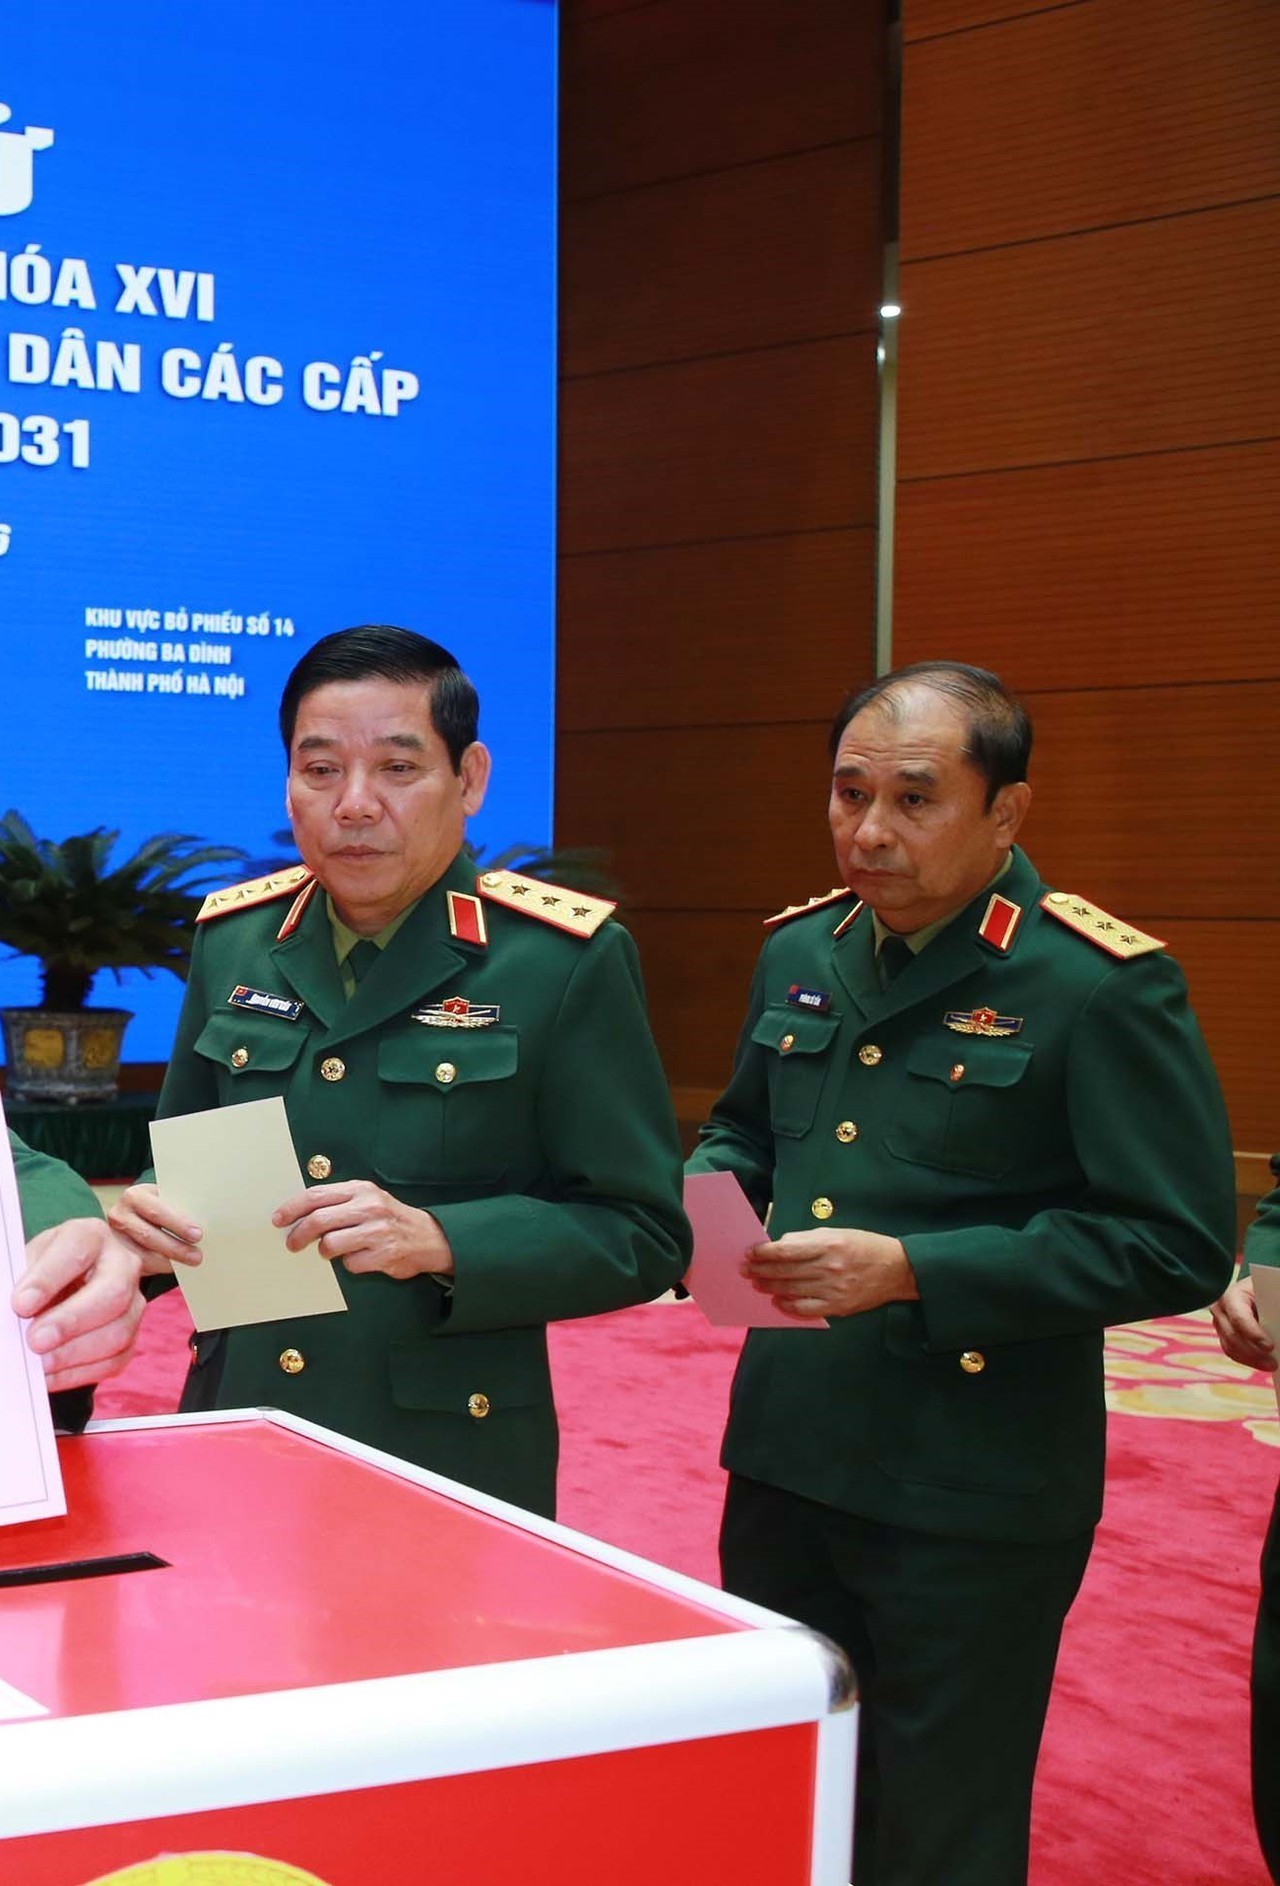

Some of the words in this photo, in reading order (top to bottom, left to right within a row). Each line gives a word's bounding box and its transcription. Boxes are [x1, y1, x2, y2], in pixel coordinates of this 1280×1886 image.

[116, 263, 215, 321] XVI
[9, 327, 141, 393] DÂN
[162, 342, 283, 405] CÁC
[303, 351, 419, 416] CẤP
[85, 607, 123, 628] KHU
[125, 609, 161, 633] VỰC
[164, 606, 189, 632] BỎ
[192, 609, 243, 634] PHIẾU
[246, 611, 270, 636] SỐ
[274, 618, 295, 637] 14
[85, 637, 158, 661] PHƯỜNG
[161, 642, 186, 662] BA
[189, 641, 231, 664] ĐÌNH
[85, 668, 144, 692] THÀNH
[147, 669, 184, 694] PHỐ
[186, 672, 211, 695] HÀ
[214, 673, 245, 699] NỘI
